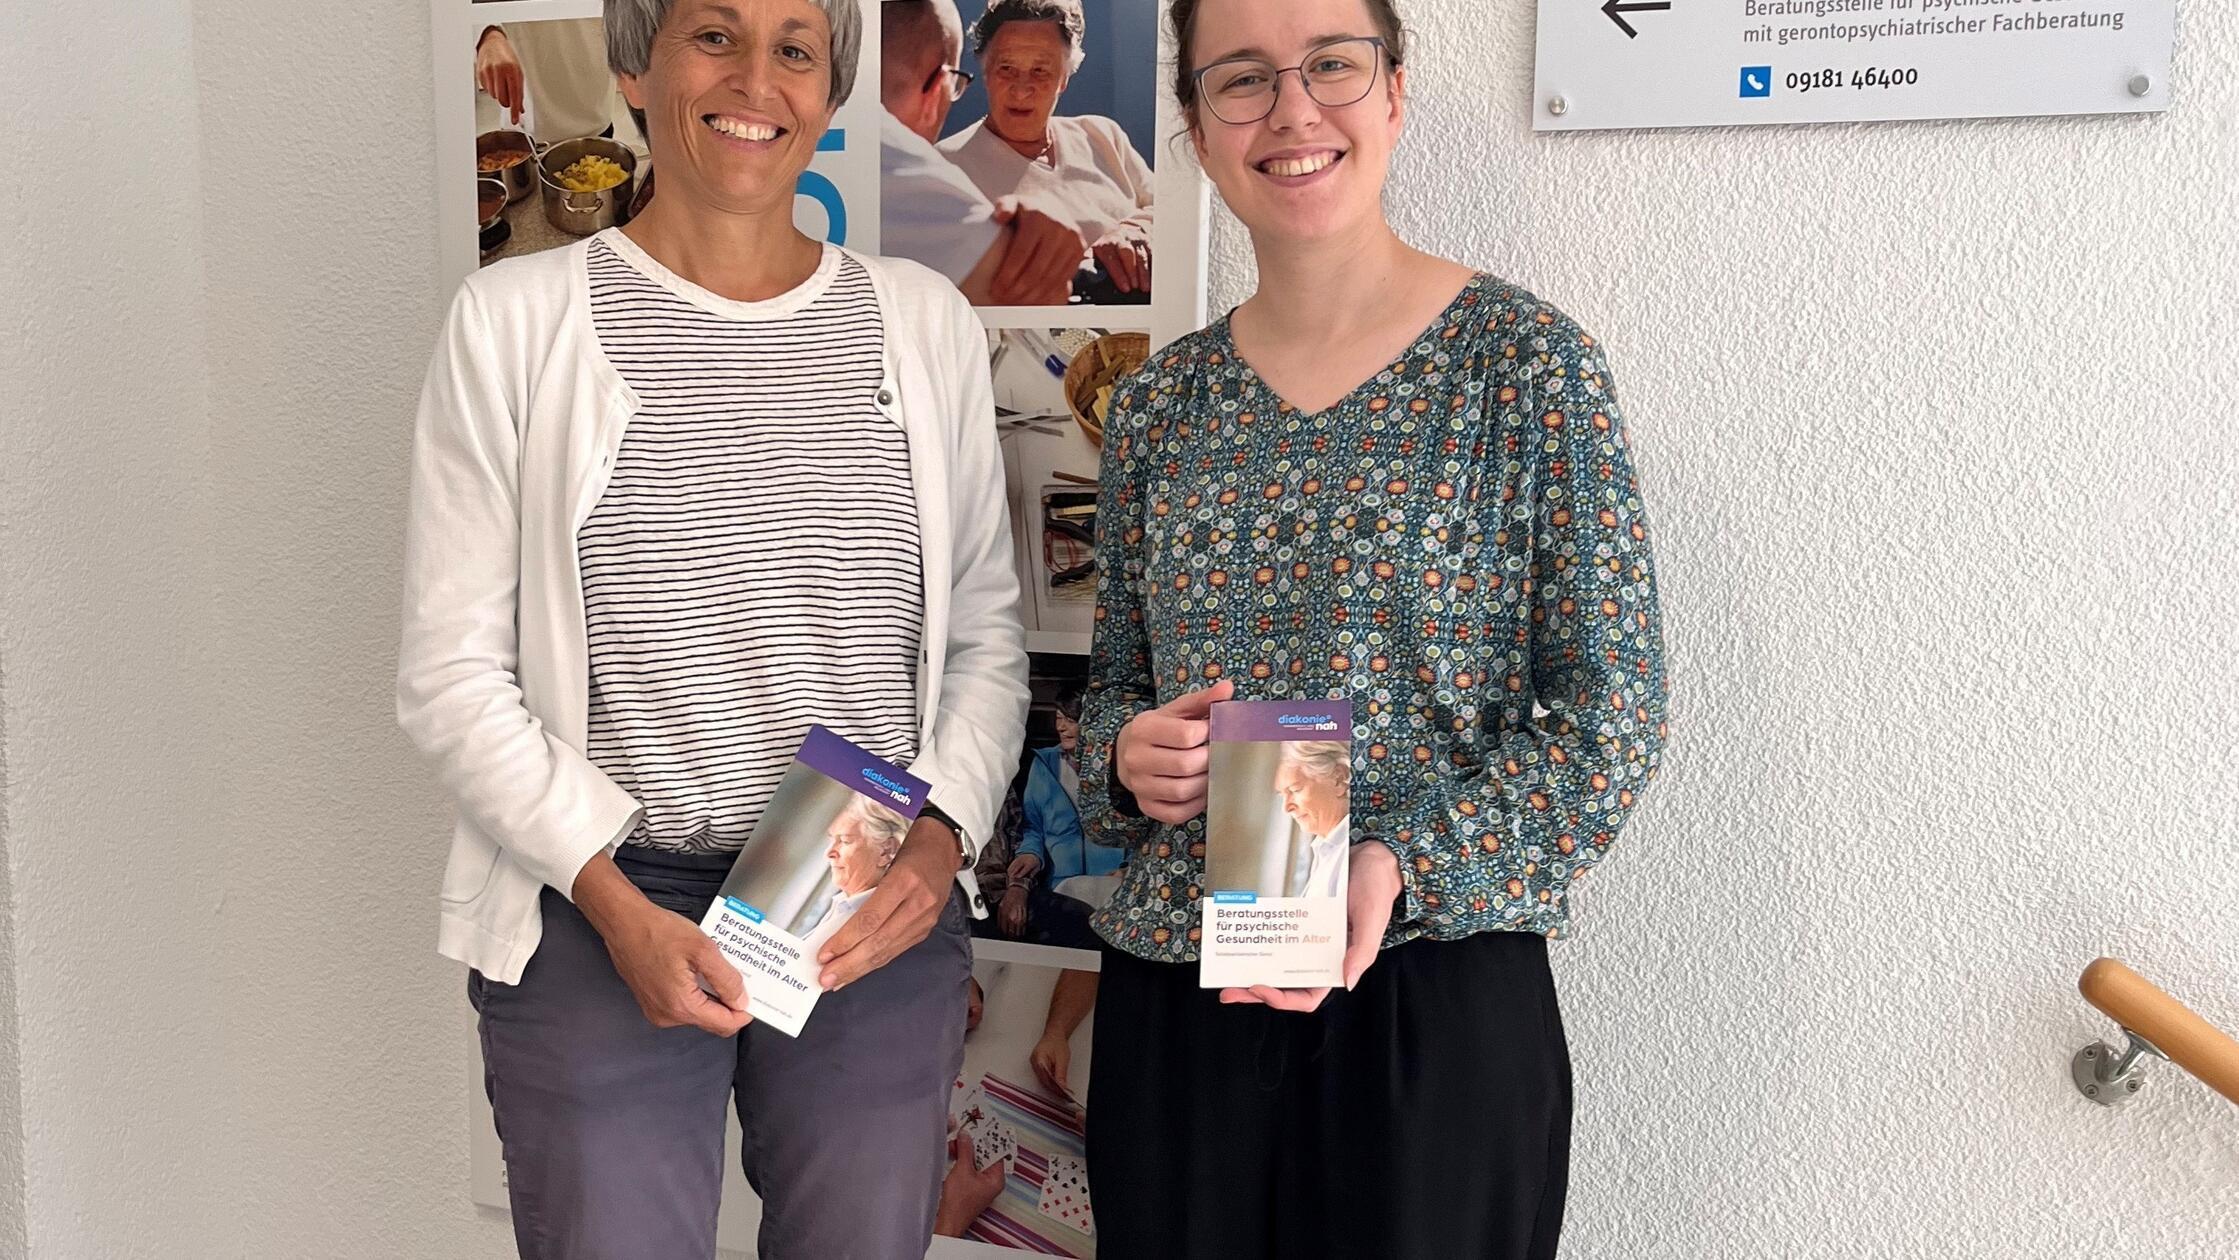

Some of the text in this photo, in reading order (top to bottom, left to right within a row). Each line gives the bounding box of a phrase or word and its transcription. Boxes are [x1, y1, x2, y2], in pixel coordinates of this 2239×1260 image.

[1745, 0, 1884, 17] Beratungsstelle
[1743, 11, 2125, 46] mit gerontopsychiatrischer Fachberatung
[1785, 66, 1919, 93] 09181 46400
[1315, 720, 1339, 731] nah
[889, 789, 912, 806] nah
[1216, 908, 1310, 920] Beratungsstelle
[1216, 921, 1300, 933] für psychische
[713, 923, 787, 967] für psychische
[720, 912, 801, 961] Beratungsstelle
[1216, 934, 1332, 944] Gesundheit im Alter
[767, 966, 781, 979] im
[782, 973, 809, 992] Alter
